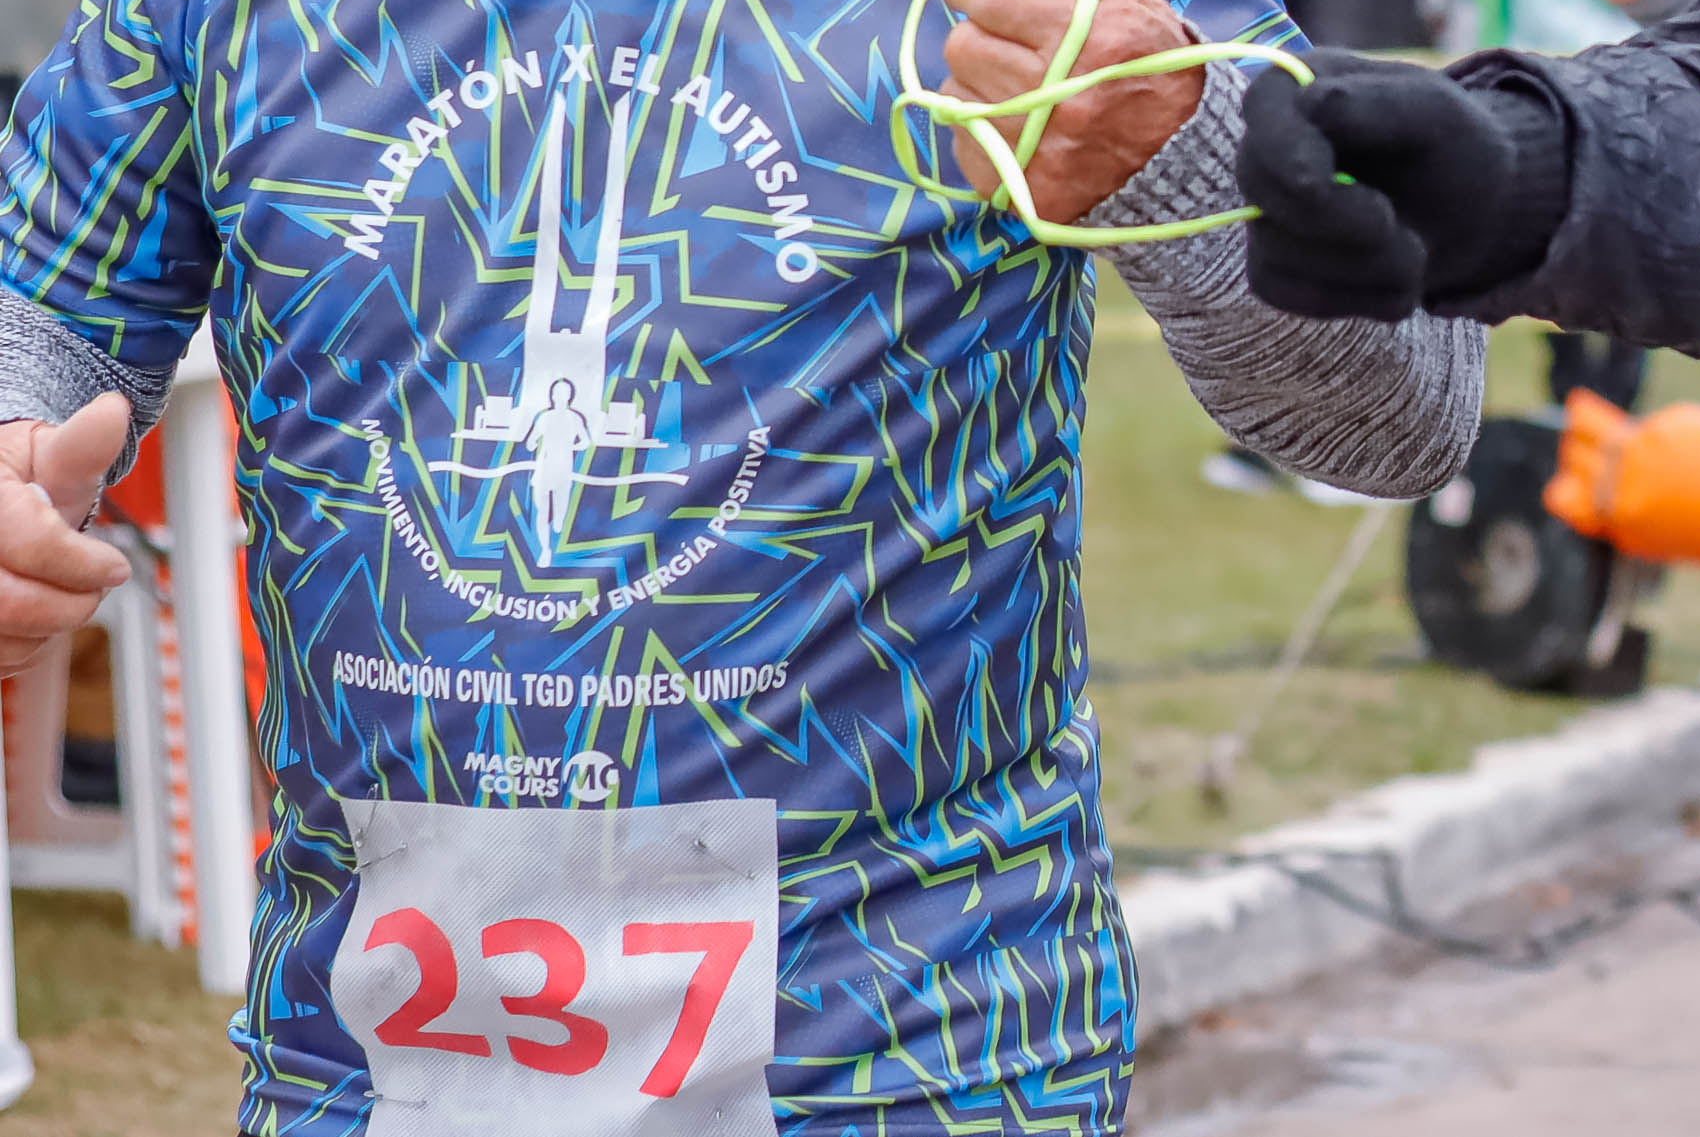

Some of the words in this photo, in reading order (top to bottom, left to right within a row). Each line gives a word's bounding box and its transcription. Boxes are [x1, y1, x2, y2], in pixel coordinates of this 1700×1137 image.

[344, 50, 543, 260] MARATÓN
[560, 43, 595, 84] X
[608, 46, 663, 95] EL
[671, 74, 819, 284] AUTISMO
[360, 418, 441, 581] MOVIMIENTO,
[444, 568, 579, 622] INCLUSIÓN
[584, 596, 602, 617] Y
[608, 536, 718, 610] ENERGÍA
[708, 426, 772, 536] POSITIVA
[333, 648, 451, 700] ASOCIACIÓN
[456, 668, 518, 706] CIVIL
[522, 672, 574, 708] TGD
[581, 671, 687, 708] PADRES
[693, 660, 790, 704] UNIDOS
[463, 751, 562, 777] MAGNY
[479, 773, 560, 798] COURS
[363, 906, 755, 1098] 237
